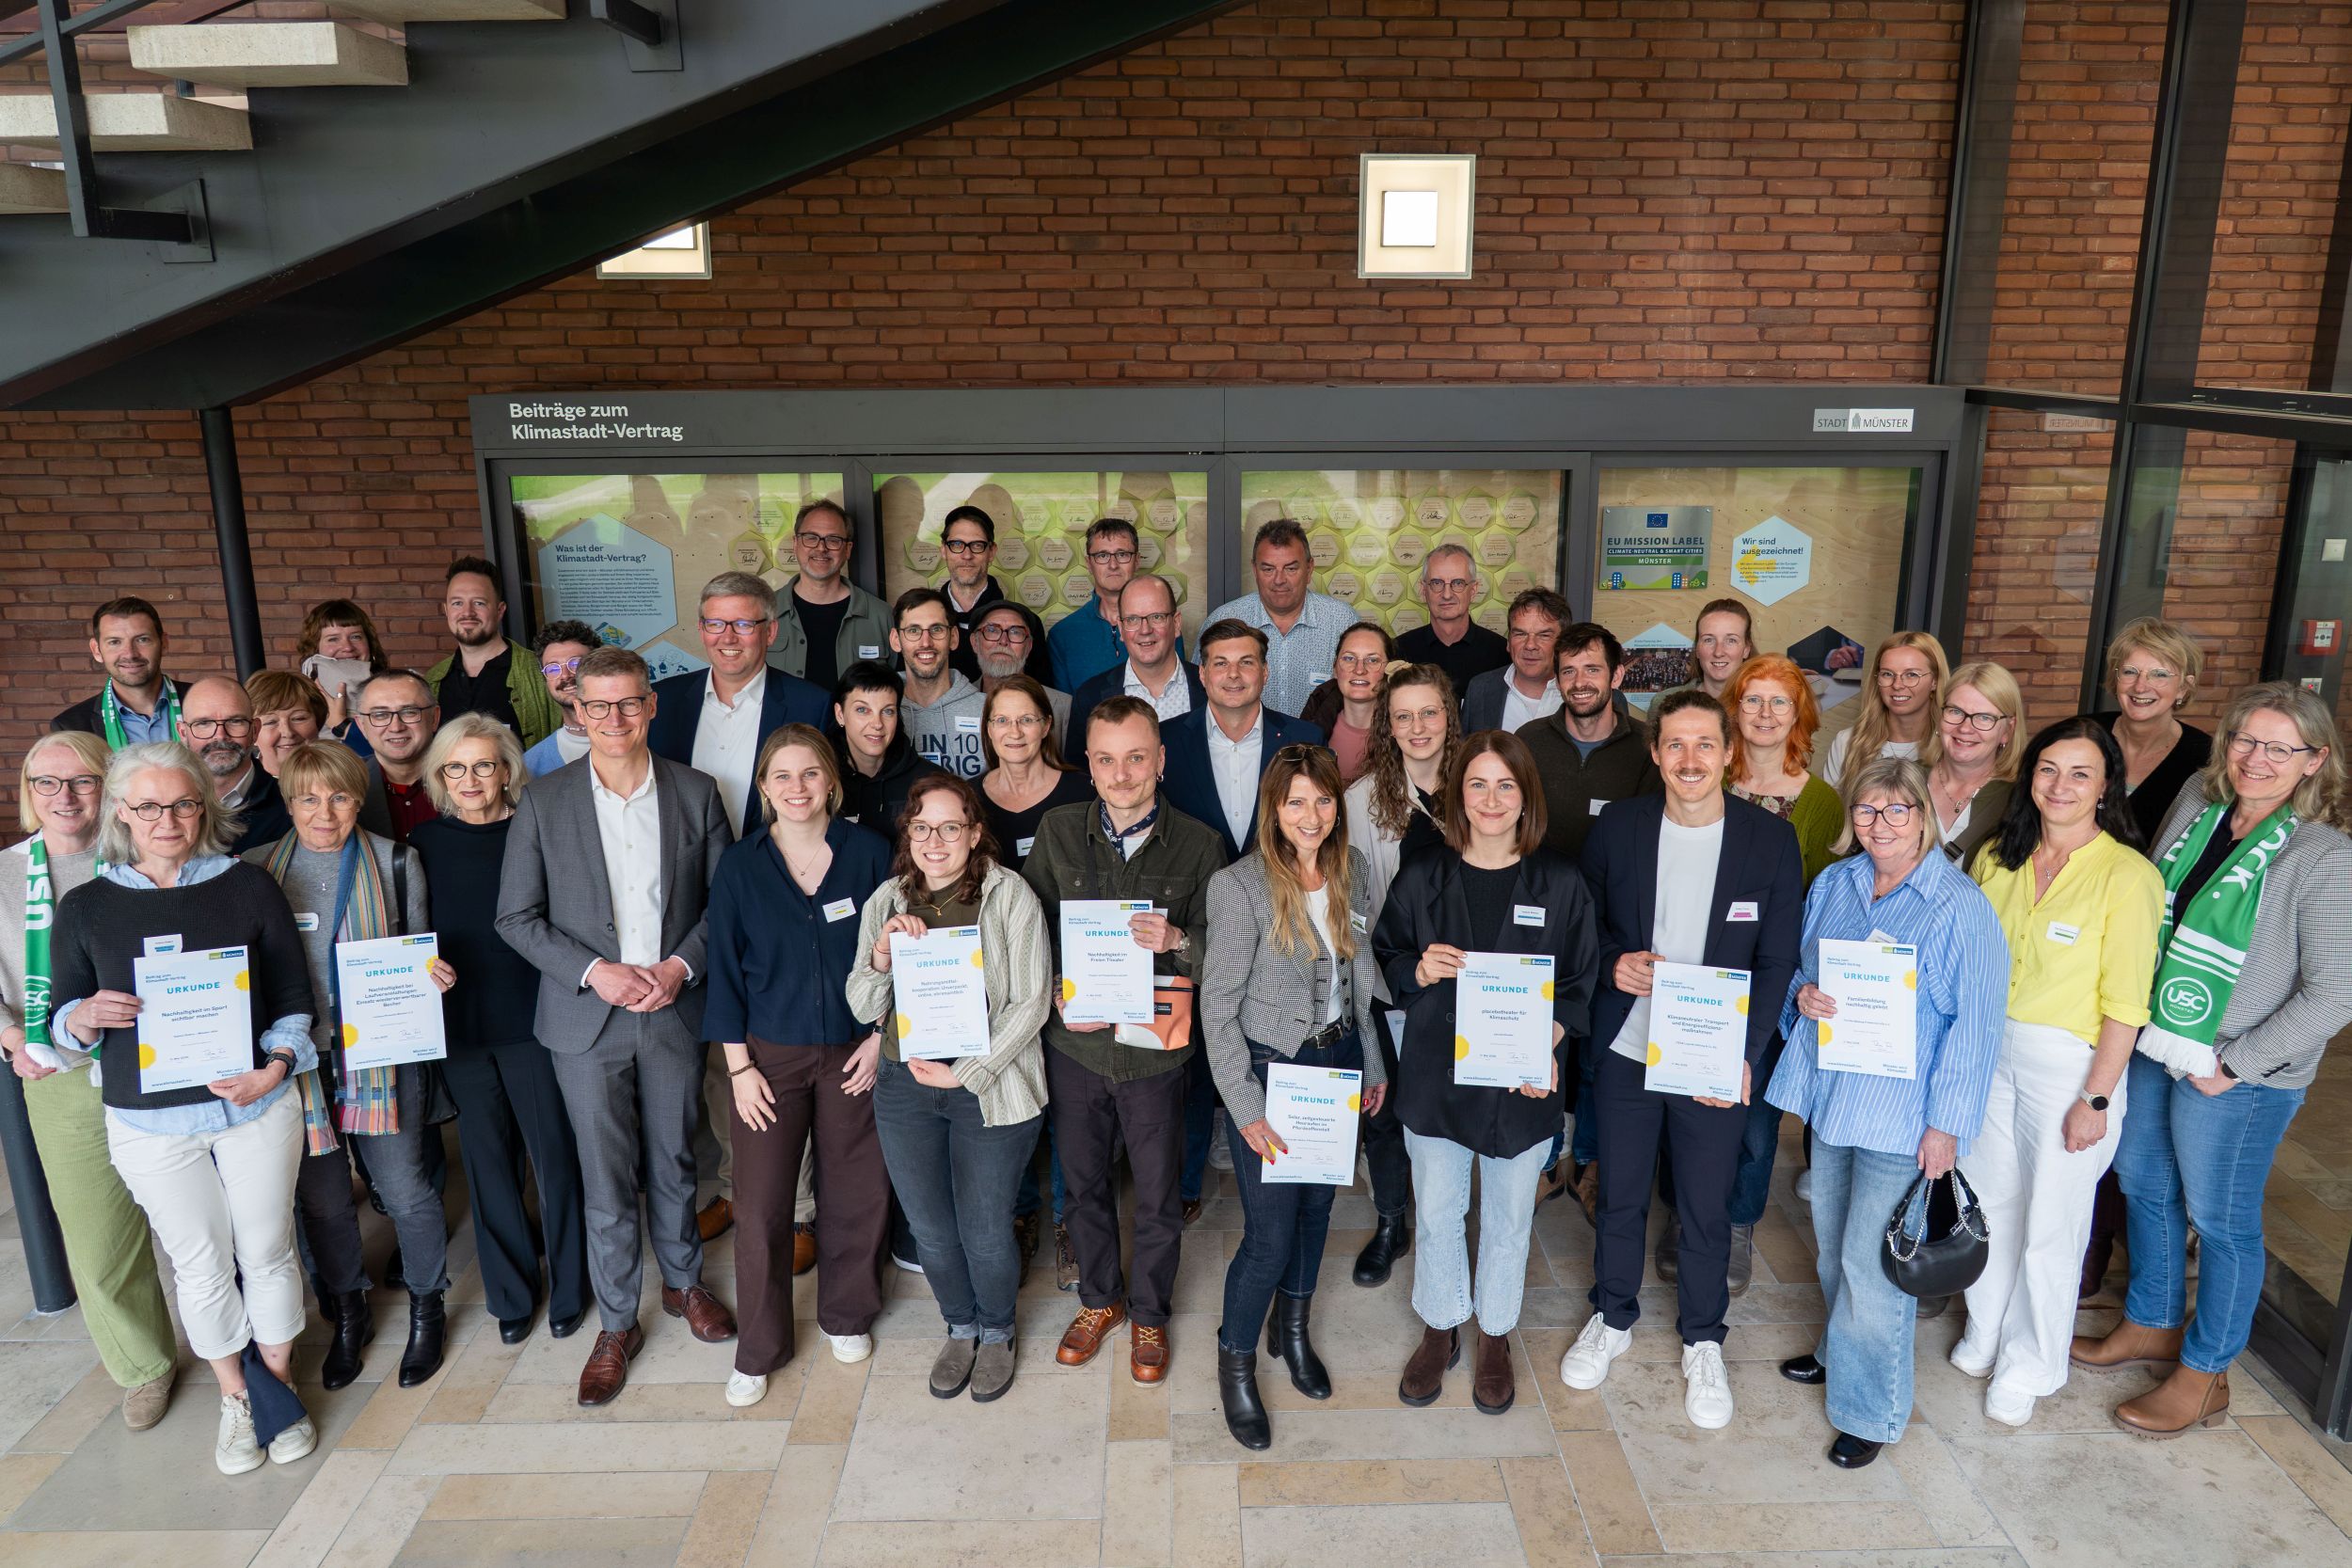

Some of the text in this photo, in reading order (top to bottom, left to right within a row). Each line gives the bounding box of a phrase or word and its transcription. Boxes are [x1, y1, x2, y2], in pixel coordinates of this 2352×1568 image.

[509, 403, 628, 420] Beiträge zum
[1817, 417, 1908, 428] STADT MÜNSTER
[511, 423, 684, 441] Klimastadt-Vertrag
[1607, 536, 1705, 546] EU MISSION LABEL
[1740, 546, 1804, 556] ausgezeichnet!
[556, 554, 646, 563] Klimastadt-Vertrag?
[954, 734, 978, 754] 10
[916, 958, 961, 968] URKUNDE
[365, 966, 413, 977] URKUNDE
[1843, 973, 1890, 982] URKUNDE
[167, 982, 221, 994] URKUNDE
[1482, 985, 1528, 994] URKUNDE
[1677, 995, 1723, 1006] URKUNDE
[2167, 986, 2206, 1011] USC
[1291, 1095, 1335, 1105] URKUNDE
